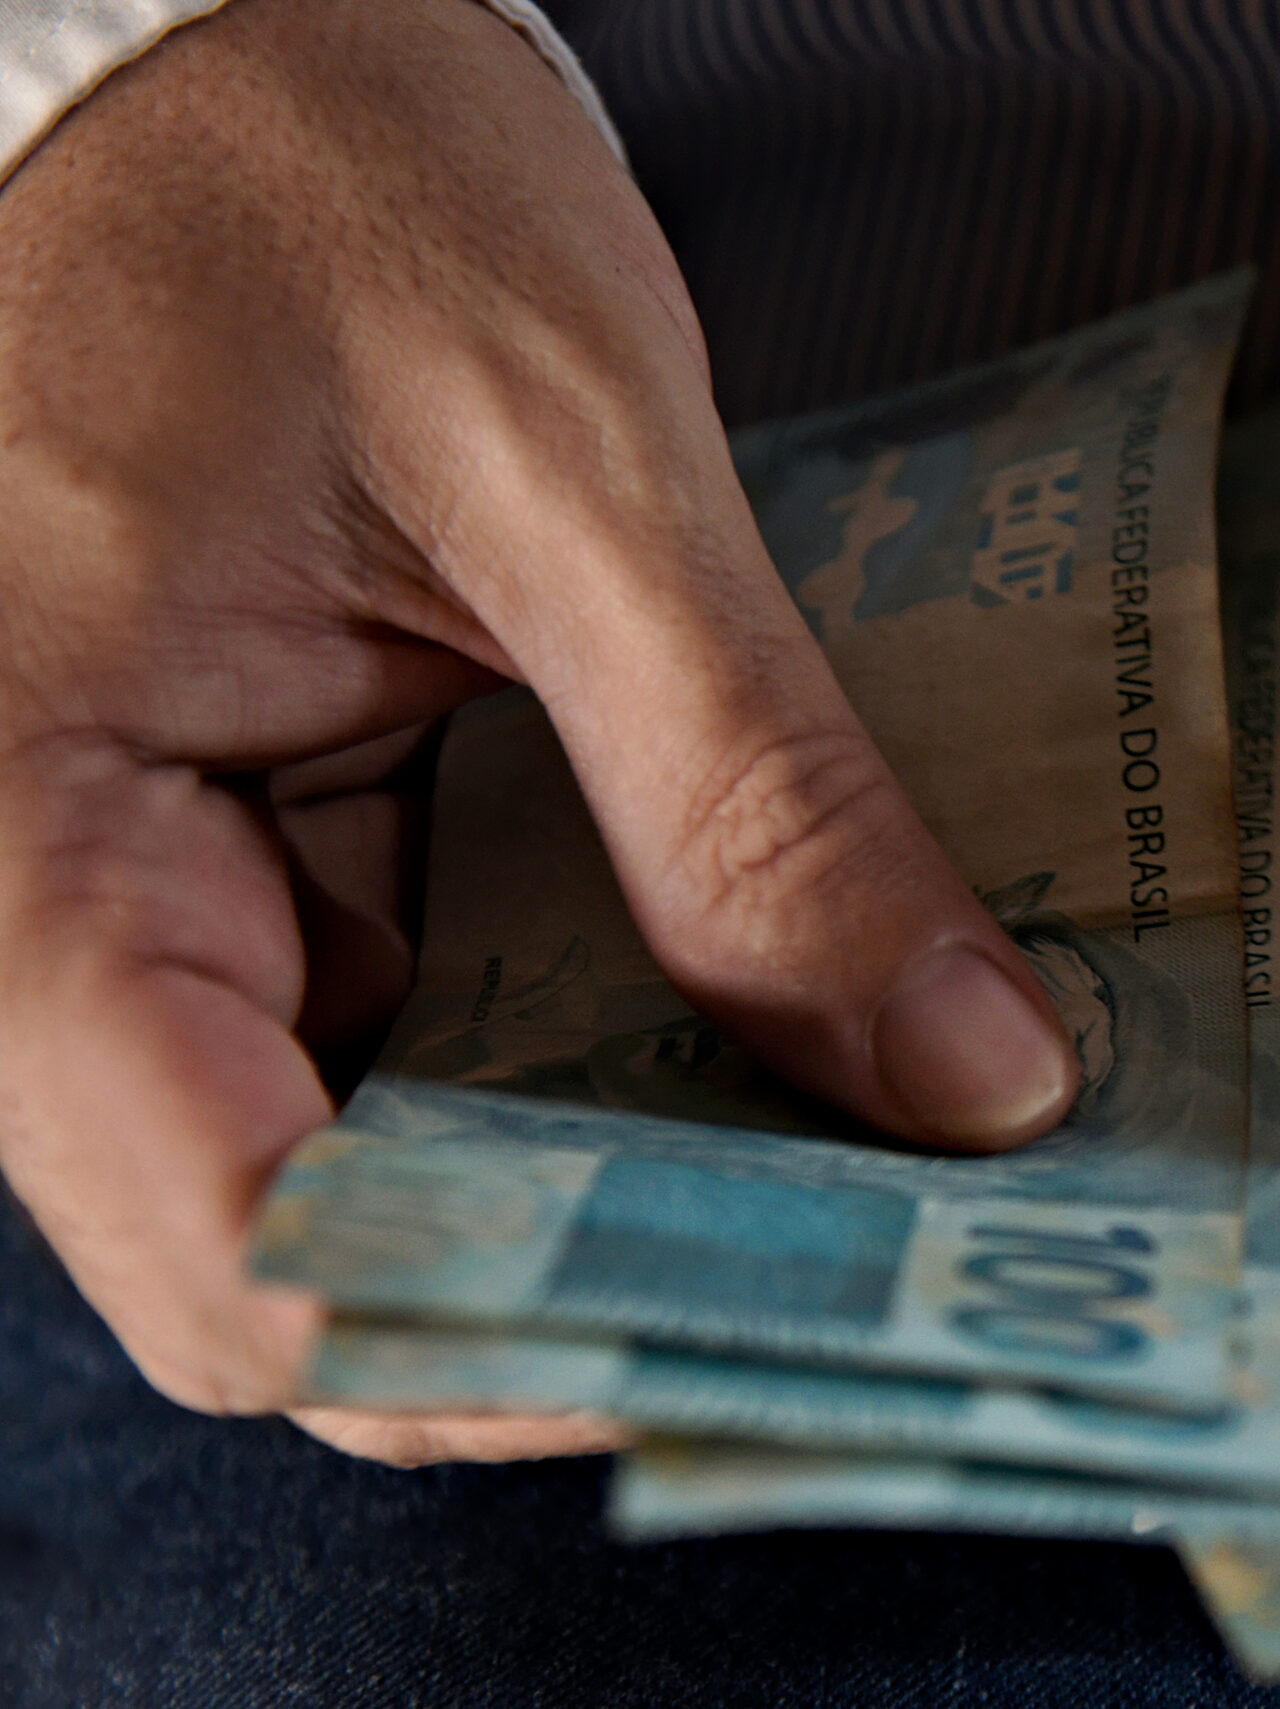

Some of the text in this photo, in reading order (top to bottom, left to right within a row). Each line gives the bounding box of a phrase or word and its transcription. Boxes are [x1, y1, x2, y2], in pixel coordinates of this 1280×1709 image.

[1112, 505, 1154, 716] FEDERATIVA
[1120, 728, 1160, 793] DO
[1126, 805, 1170, 943] BRASIL
[1240, 851, 1272, 899] DO
[952, 1222, 1157, 1362] 100
